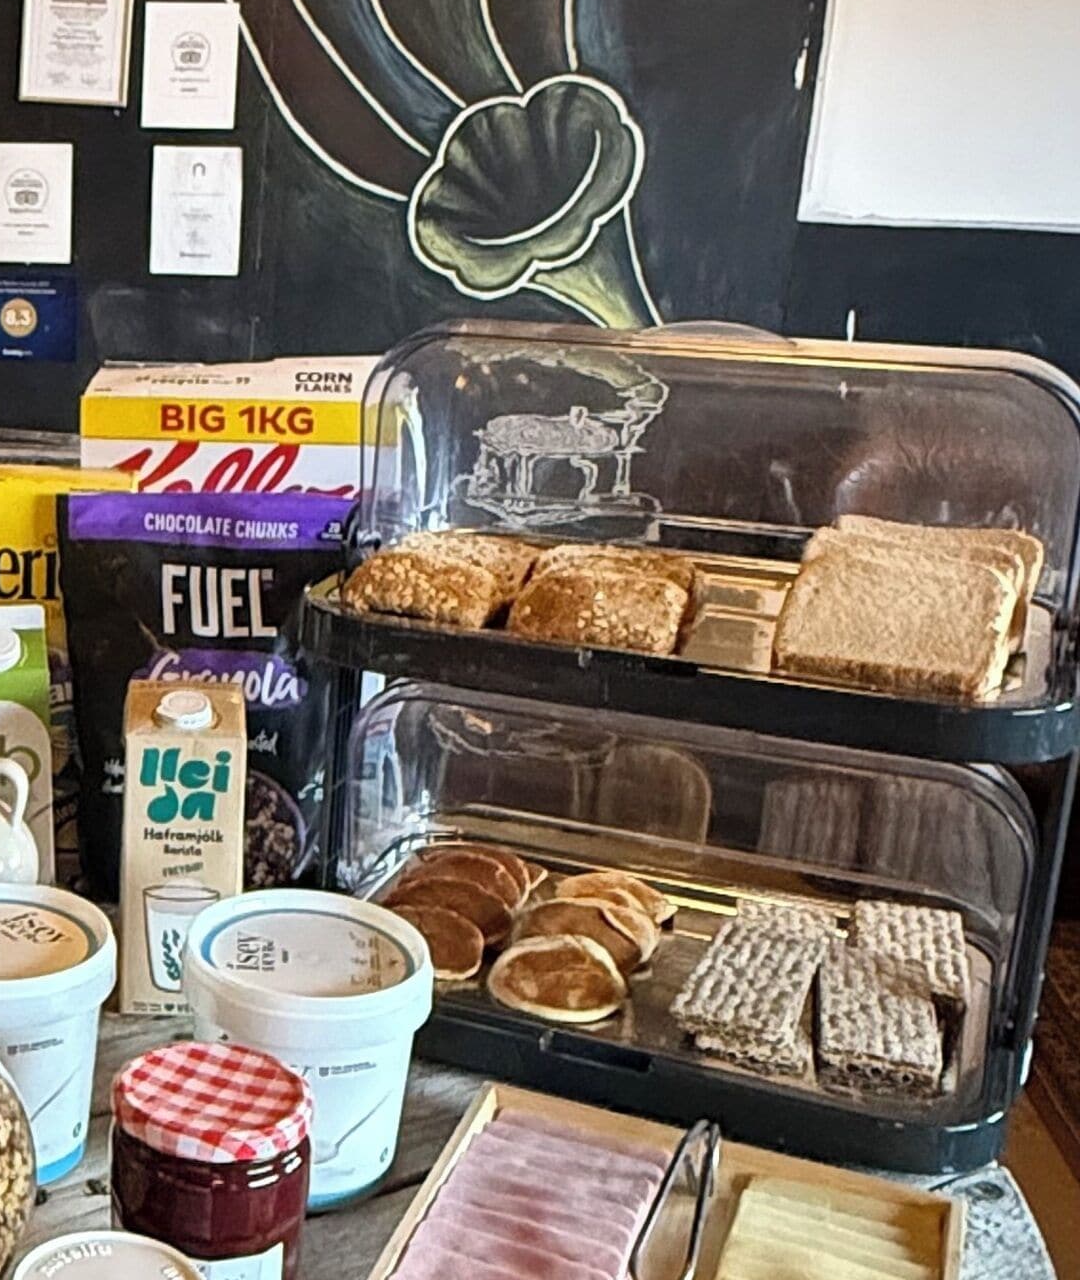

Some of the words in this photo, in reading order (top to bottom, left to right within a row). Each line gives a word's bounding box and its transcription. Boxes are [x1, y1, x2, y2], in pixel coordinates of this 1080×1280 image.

[295, 372, 352, 384] CORN
[295, 383, 352, 393] FLAKES
[160, 404, 225, 433] BIG
[238, 406, 314, 435] 1KG
[144, 512, 231, 536] CHOCOLATE
[235, 519, 298, 539] CHUNKS
[162, 563, 278, 638] FUEL
[143, 826, 224, 844] Haframjólk
[163, 843, 203, 856] Barista
